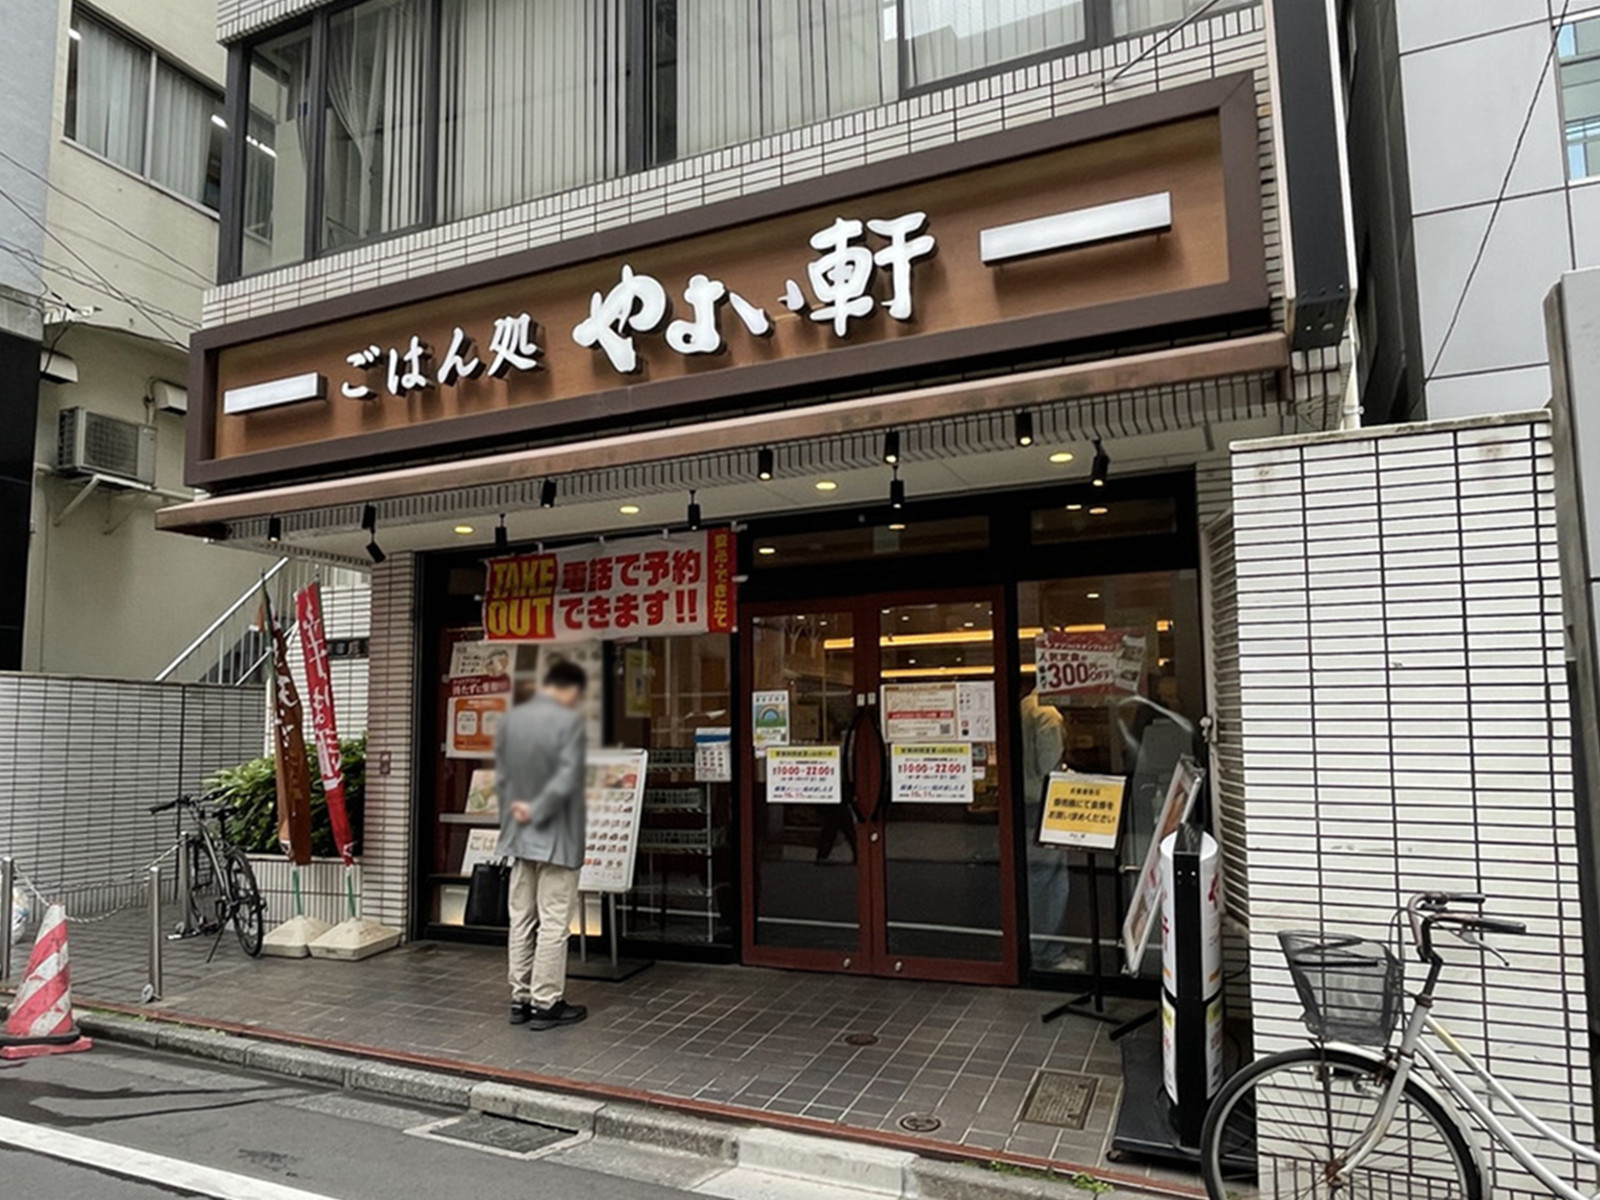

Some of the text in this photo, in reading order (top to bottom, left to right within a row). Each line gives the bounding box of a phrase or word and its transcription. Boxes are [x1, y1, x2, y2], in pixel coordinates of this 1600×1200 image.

[341, 211, 935, 399] ごはん処 やよい軒
[493, 558, 555, 598] TAKE
[562, 549, 701, 593] 電話で予約
[487, 597, 551, 636] OUT
[1047, 662, 1089, 688] 300
